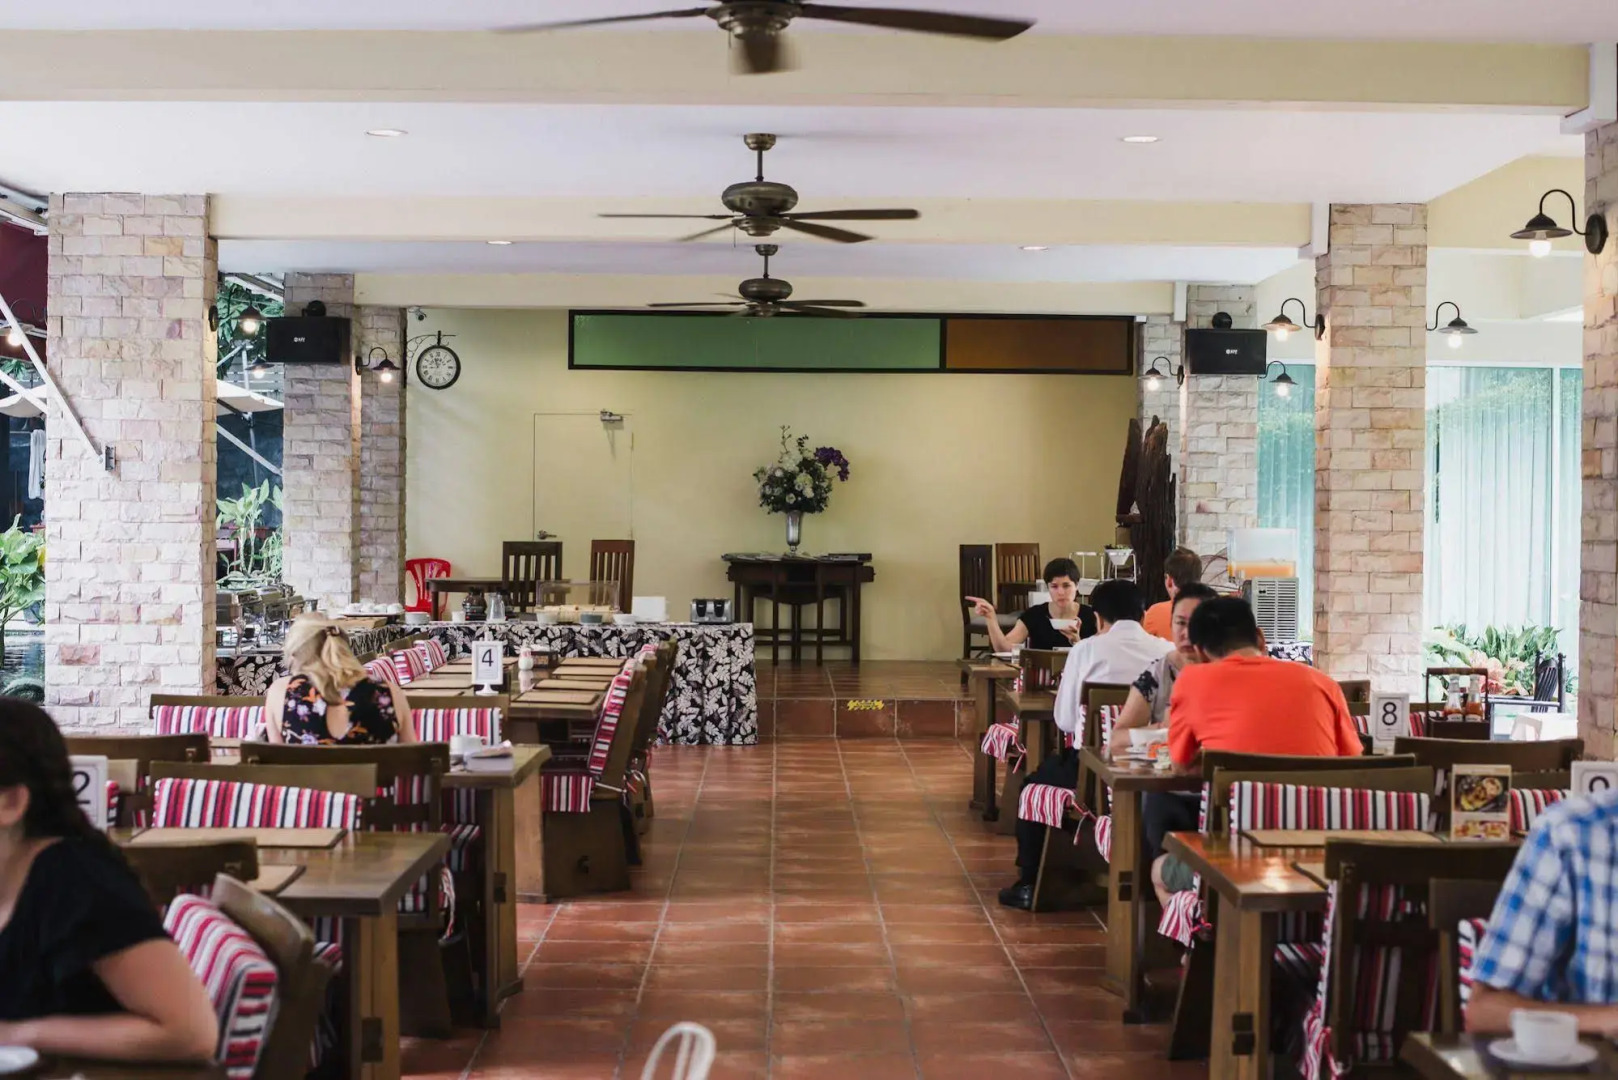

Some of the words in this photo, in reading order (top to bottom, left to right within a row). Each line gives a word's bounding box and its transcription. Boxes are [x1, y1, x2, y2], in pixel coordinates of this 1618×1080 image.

[481, 648, 494, 667] 4
[1382, 701, 1397, 726] 8
[73, 770, 91, 805] 2
